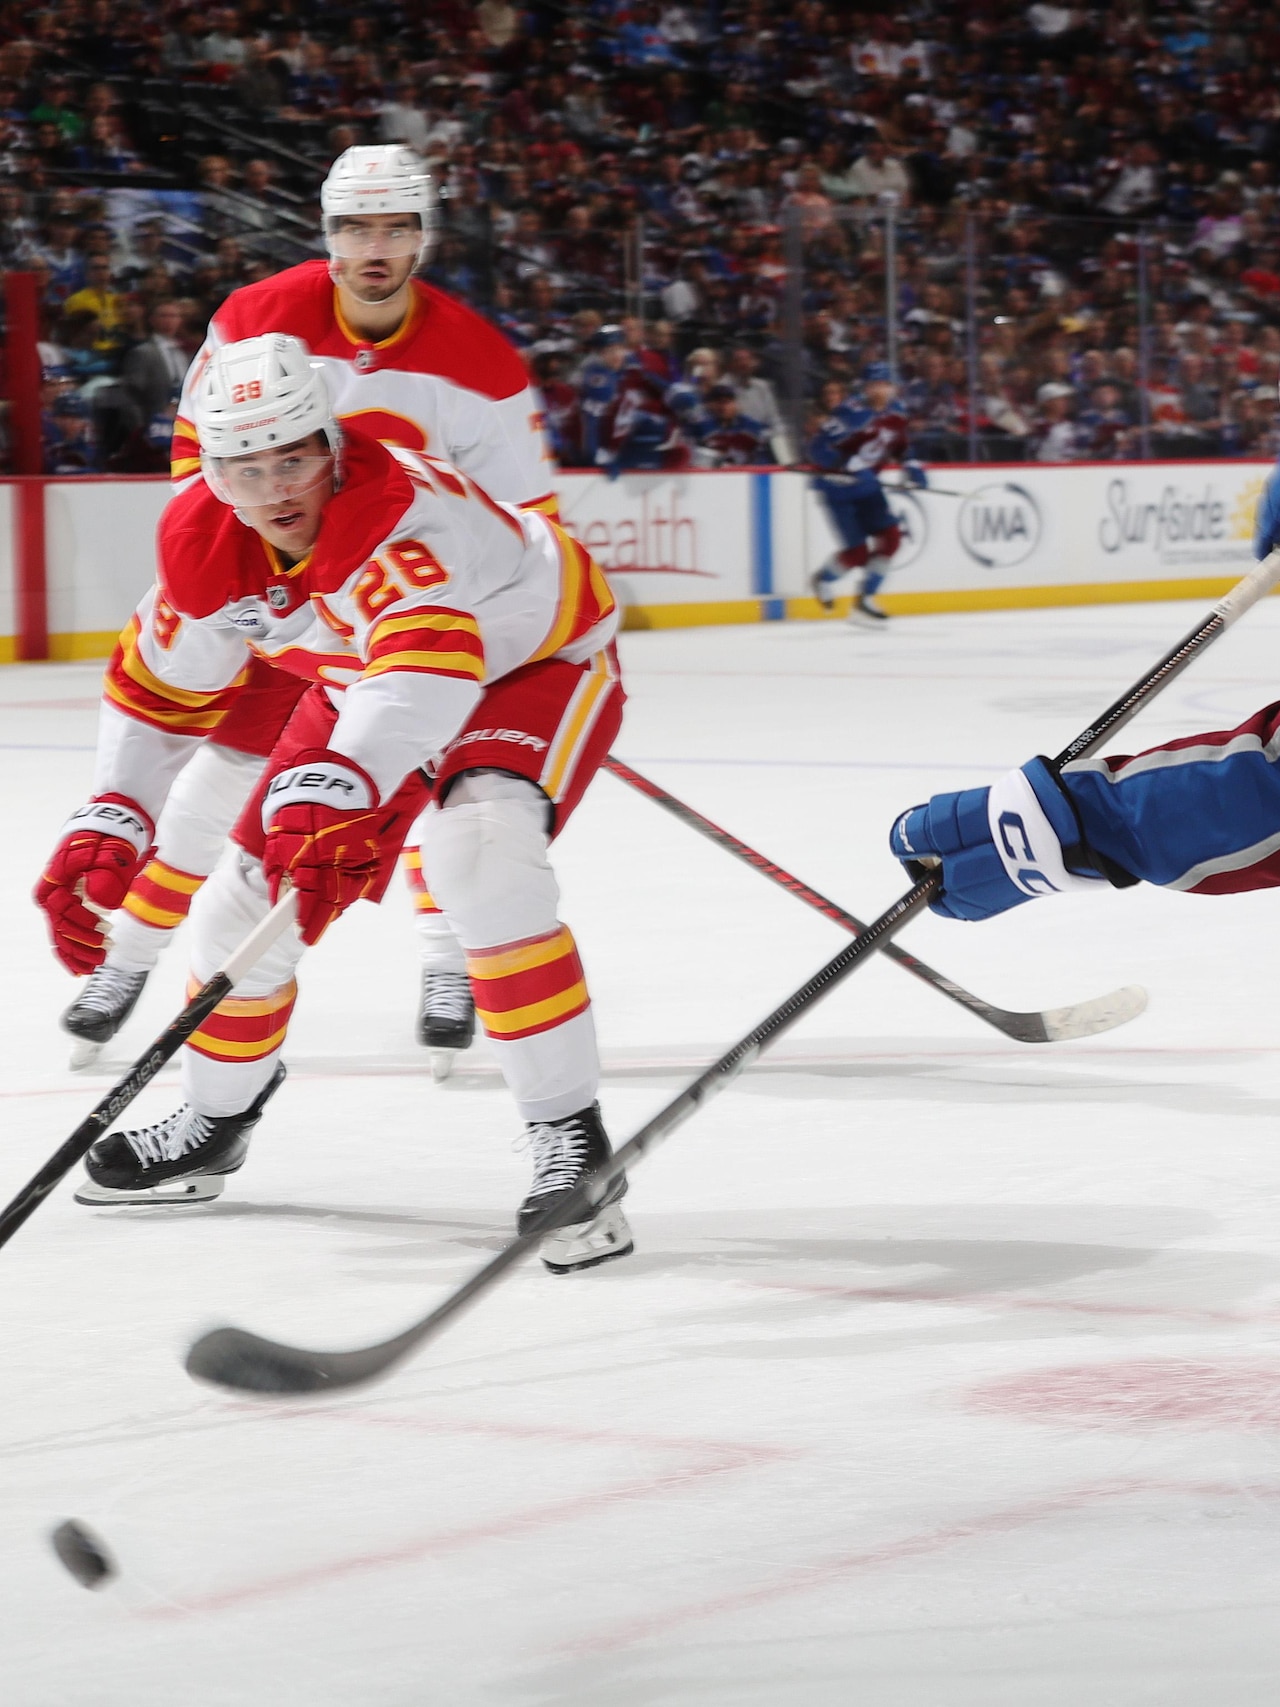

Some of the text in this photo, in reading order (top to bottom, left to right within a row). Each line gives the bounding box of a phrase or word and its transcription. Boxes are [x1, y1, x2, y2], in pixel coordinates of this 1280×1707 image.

[231, 380, 263, 404] 28
[972, 505, 1029, 543] IMA
[1101, 479, 1226, 554] Surfside
[352, 538, 449, 623] 28
